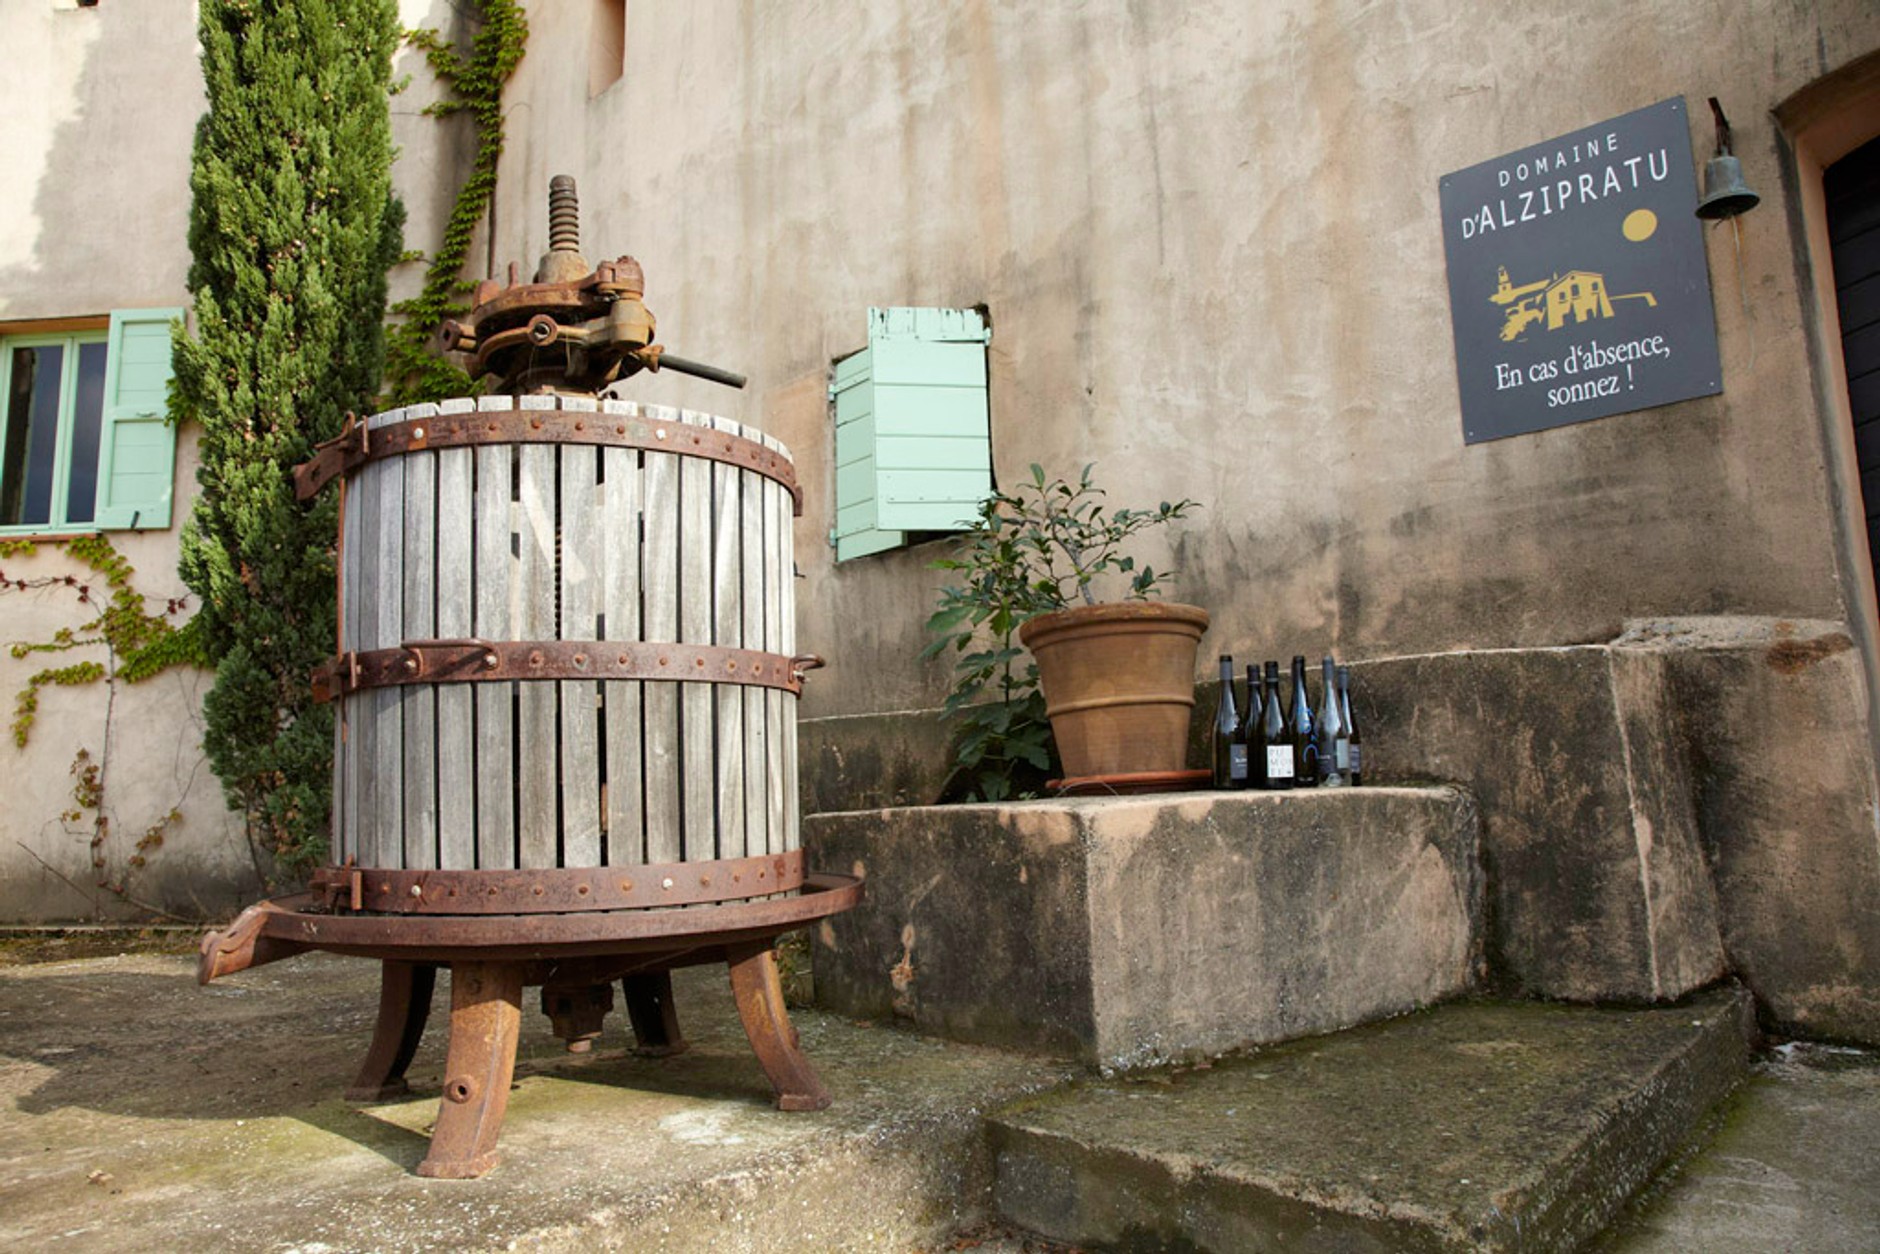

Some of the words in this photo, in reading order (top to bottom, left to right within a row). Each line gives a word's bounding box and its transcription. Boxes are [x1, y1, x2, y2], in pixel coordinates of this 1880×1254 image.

[1498, 132, 1619, 188] DOMAINE
[1461, 148, 1669, 239] D'ALZIPRATU
[1495, 363, 1523, 391] En
[1529, 359, 1558, 382] cas
[1547, 375, 1620, 408] sonnez
